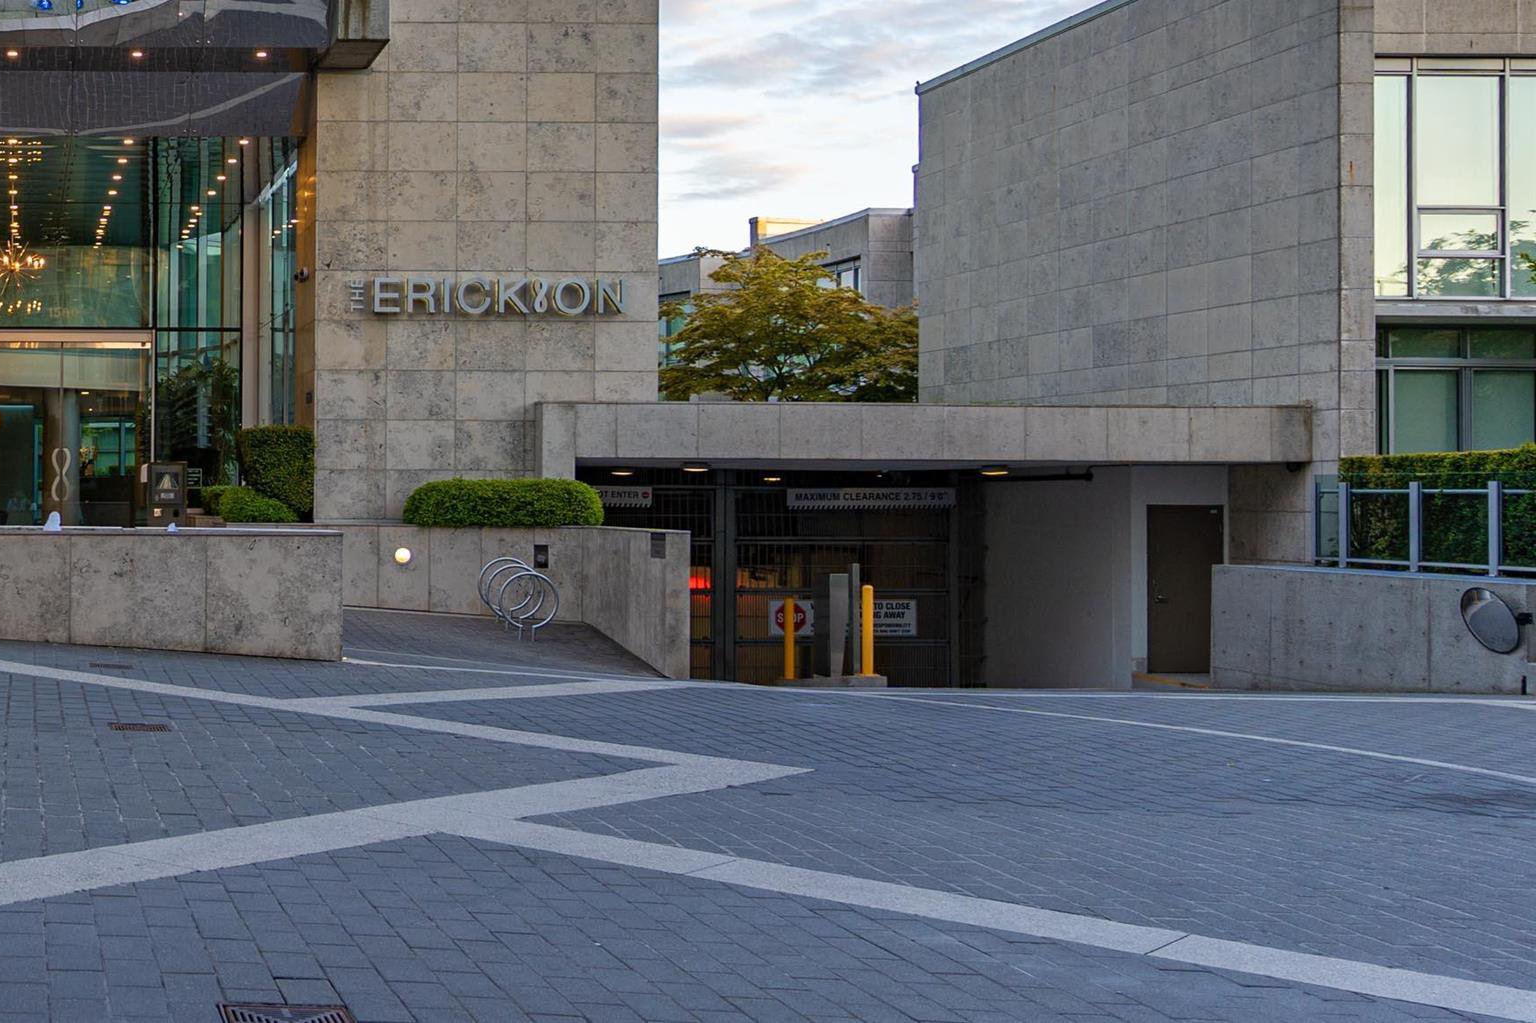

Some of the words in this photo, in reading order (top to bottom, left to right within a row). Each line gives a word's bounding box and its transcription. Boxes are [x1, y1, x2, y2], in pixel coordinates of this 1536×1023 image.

[350, 279, 364, 312] THE
[611, 490, 639, 499] ENTER
[795, 492, 840, 501] MAXIMUM
[843, 492, 901, 501] CLEARANCE
[885, 602, 911, 610] CLOSE
[776, 612, 805, 623] SP
[883, 611, 906, 619] AWAY
